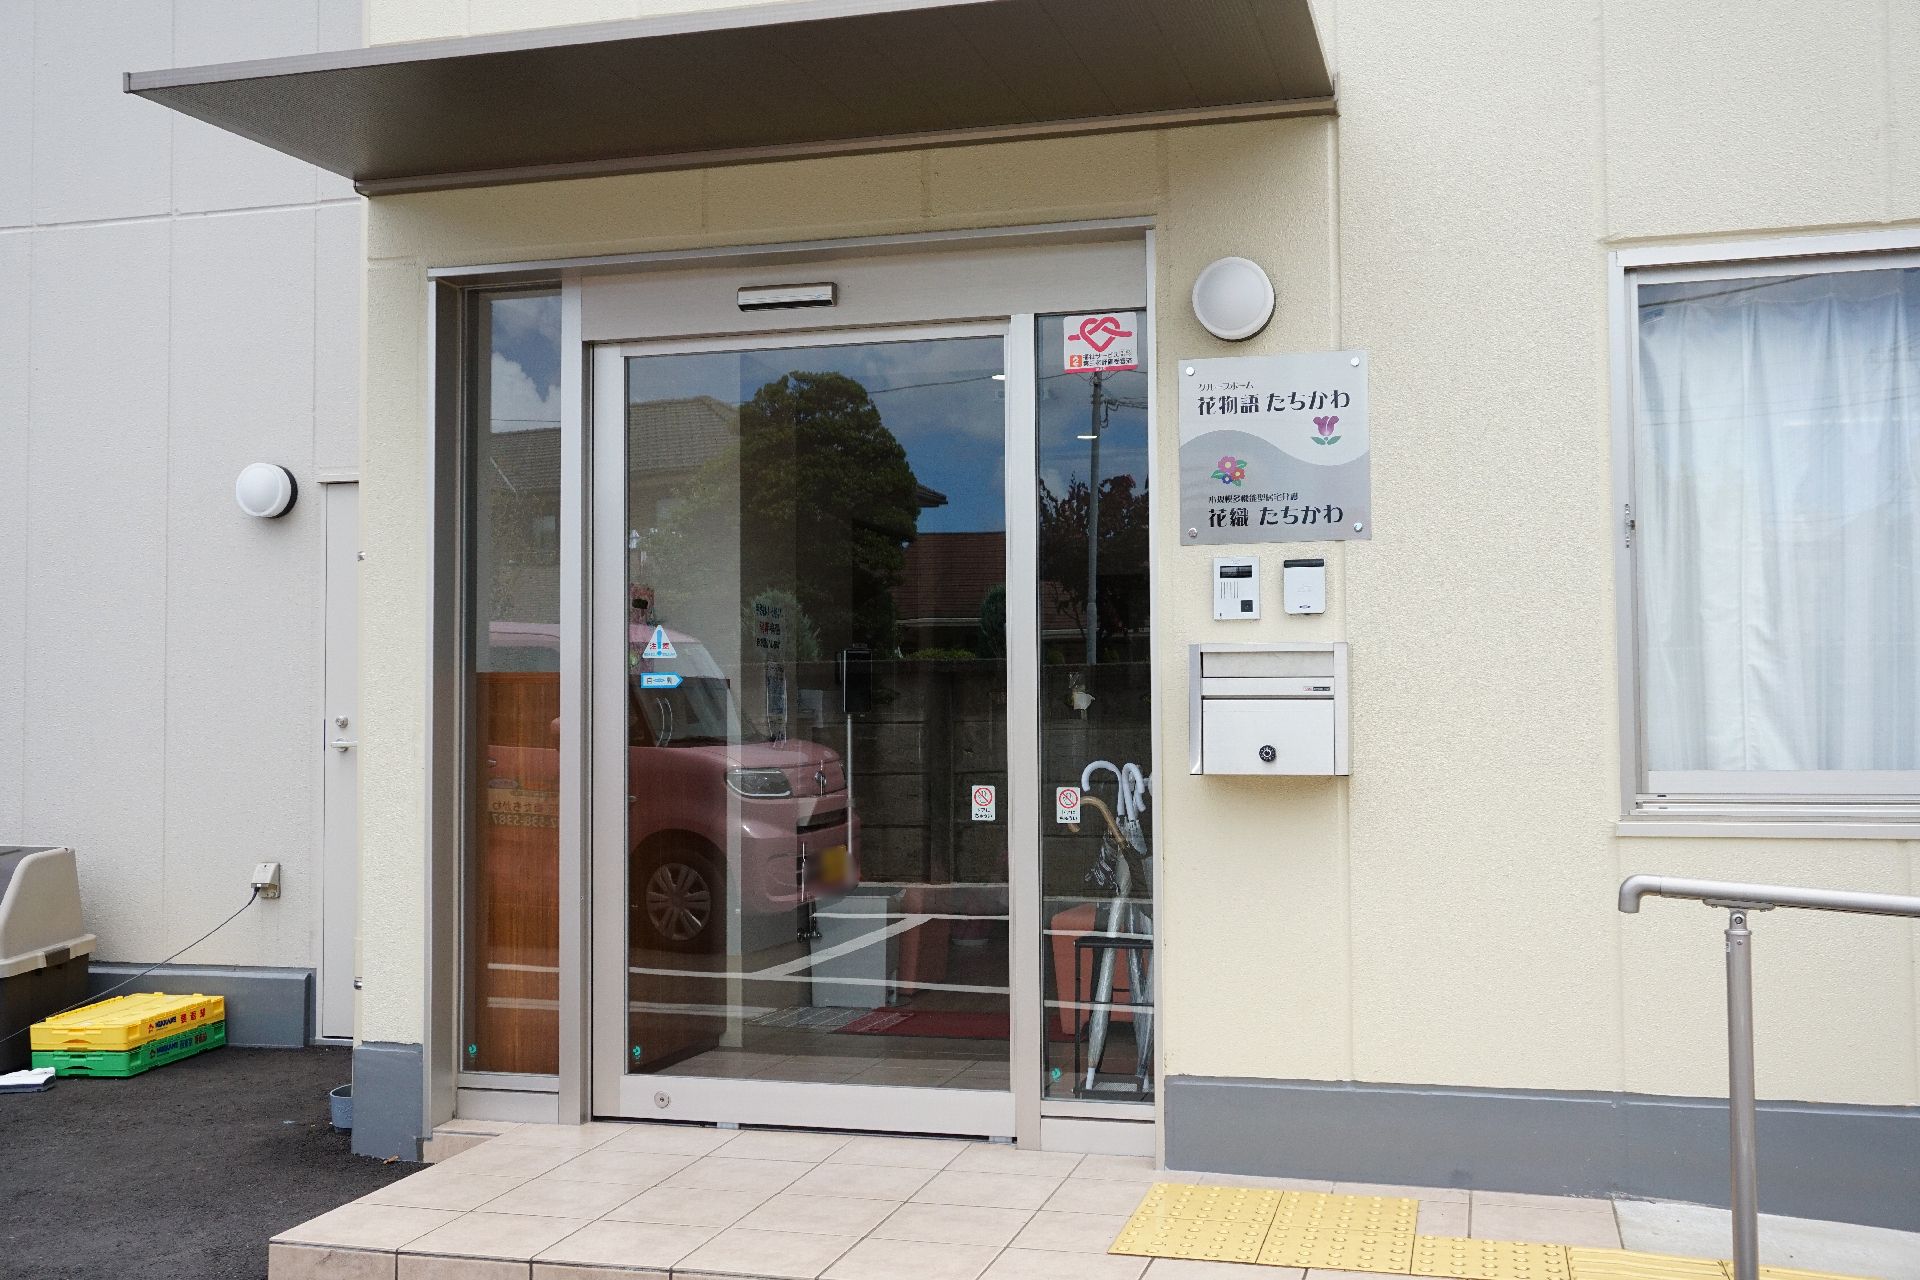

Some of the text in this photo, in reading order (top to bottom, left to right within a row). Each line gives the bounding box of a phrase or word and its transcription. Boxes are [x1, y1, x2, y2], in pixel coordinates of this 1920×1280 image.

[1198, 381, 1254, 391] グループホーム
[1197, 389, 1351, 416] 花物語 たちかわ
[1208, 504, 1344, 528] 花織 たちかわ
